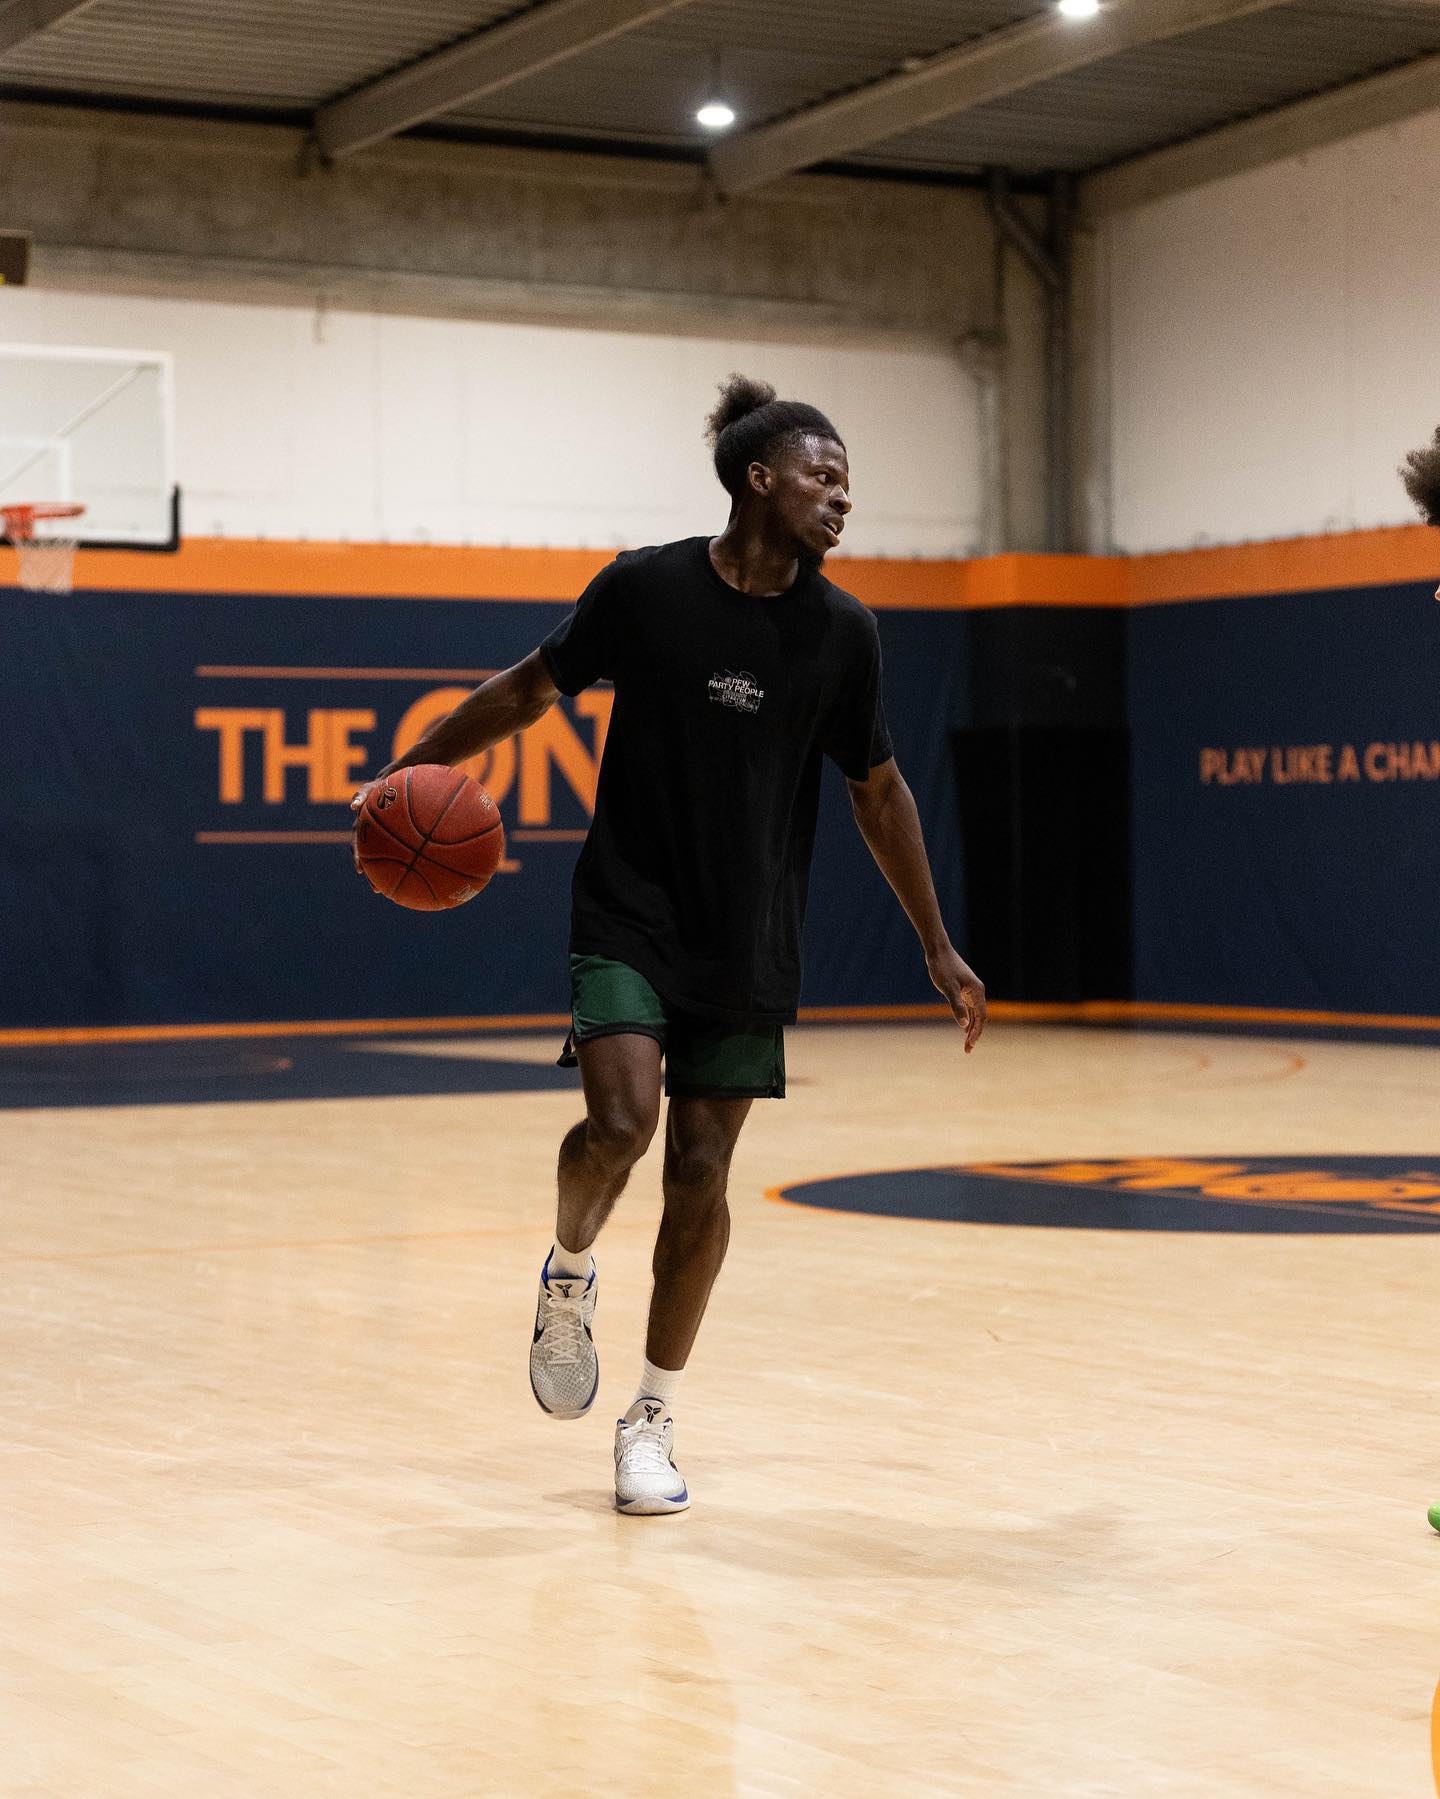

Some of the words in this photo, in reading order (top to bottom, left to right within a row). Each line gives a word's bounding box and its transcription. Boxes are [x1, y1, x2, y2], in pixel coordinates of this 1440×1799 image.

[708, 680, 734, 690] PARTY
[735, 685, 764, 698] PEOPLE
[194, 707, 376, 804] THE
[1200, 746, 1267, 785] PLAY
[1270, 744, 1333, 784] LIKE
[1337, 743, 1361, 782] A
